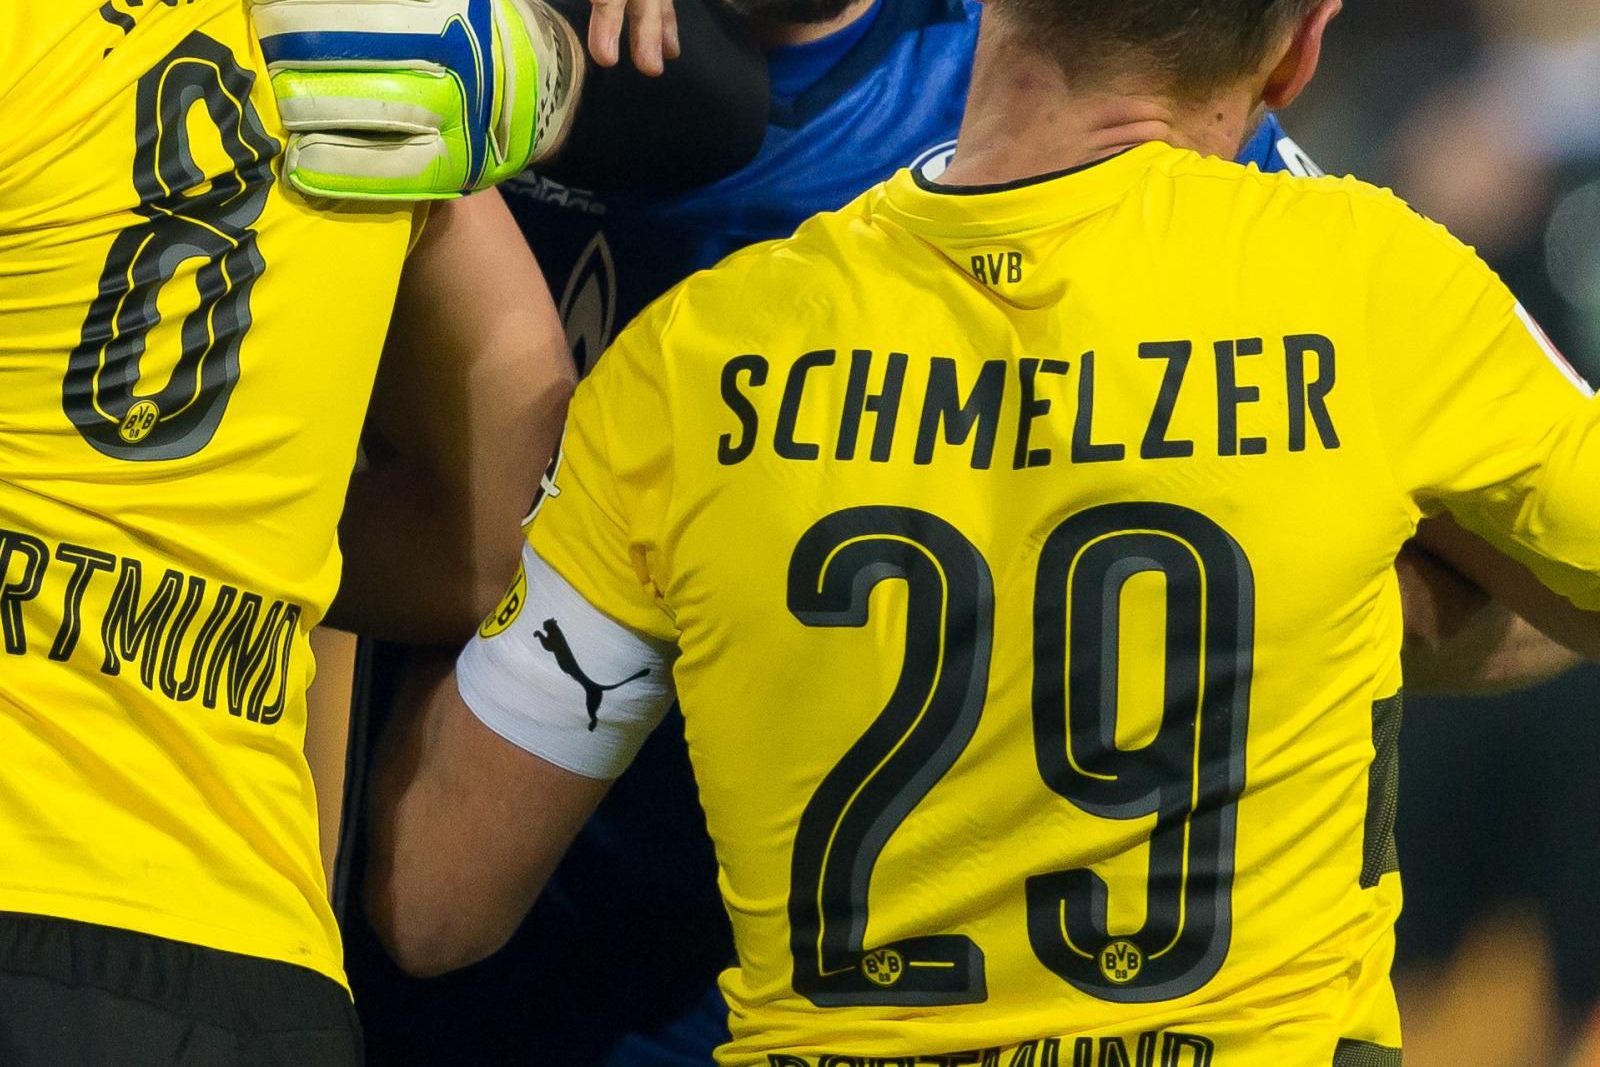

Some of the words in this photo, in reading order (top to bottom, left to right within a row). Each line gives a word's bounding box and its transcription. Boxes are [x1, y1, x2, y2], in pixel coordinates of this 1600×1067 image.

[61, 29, 282, 462] 8
[971, 251, 1022, 285] BVB
[123, 405, 155, 430] BVB
[716, 333, 1341, 470] SCHMELZER
[786, 500, 1256, 1008] 29
[865, 950, 899, 974] BVB
[1104, 944, 1139, 970] BVB
